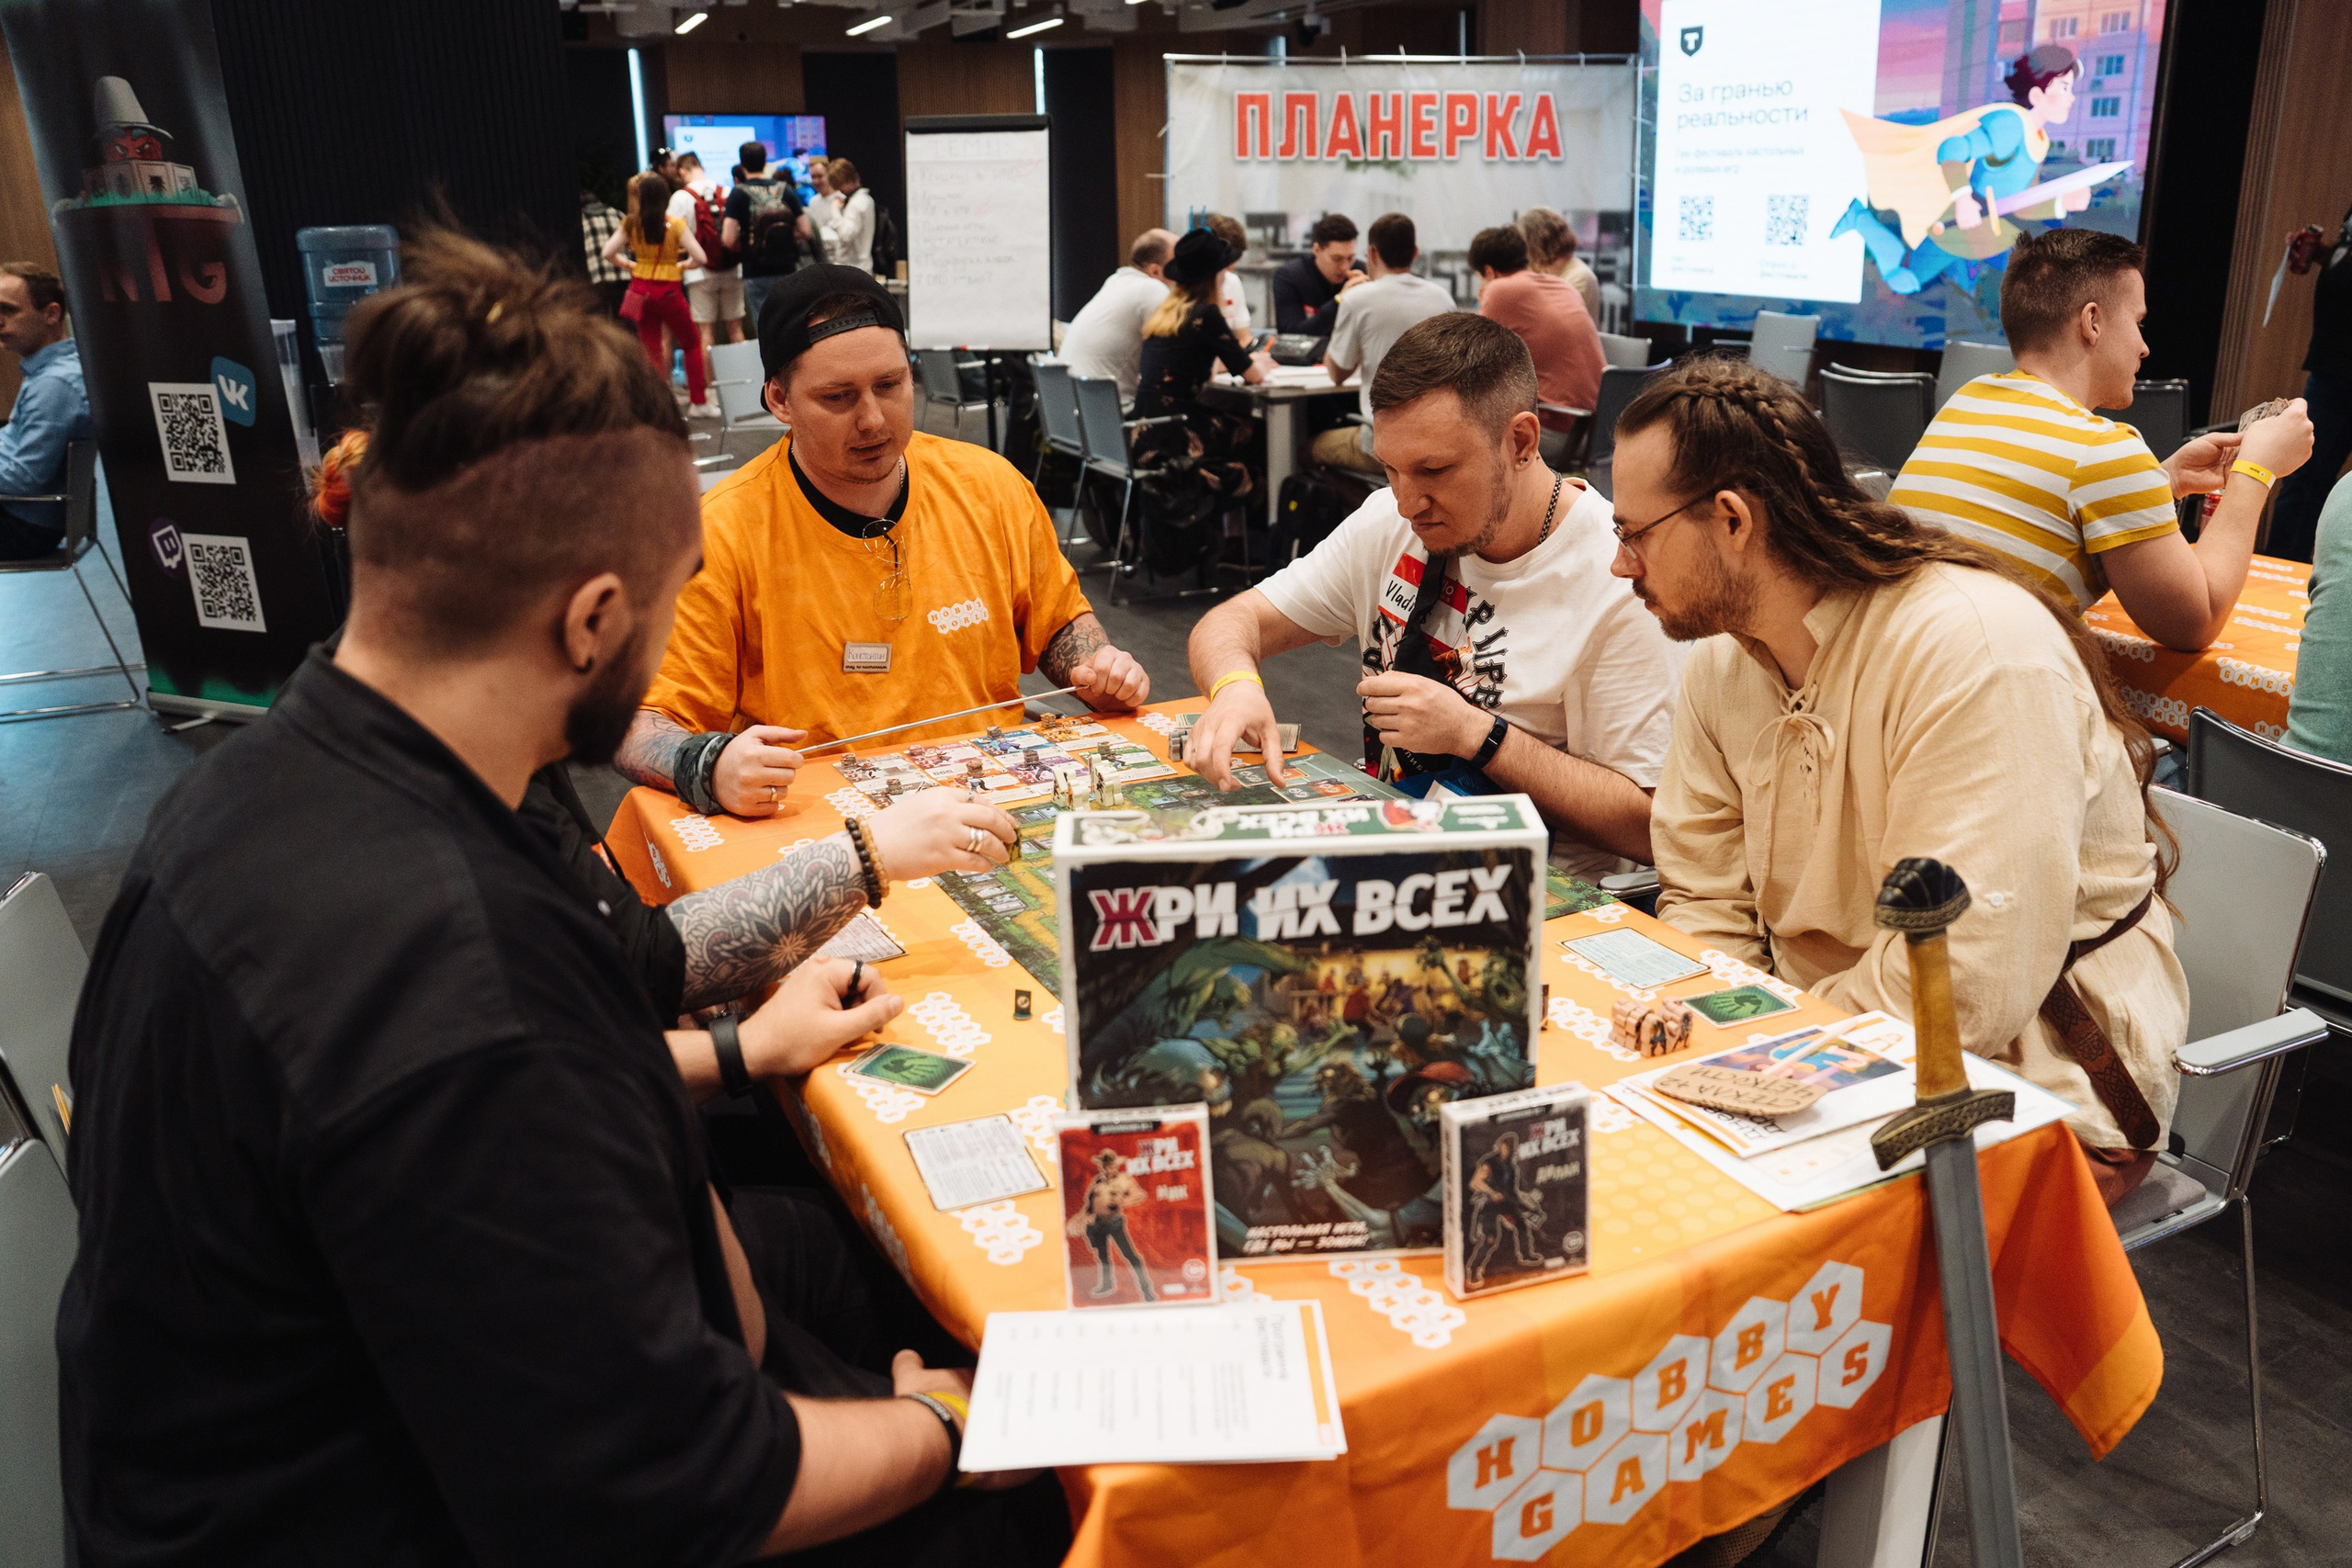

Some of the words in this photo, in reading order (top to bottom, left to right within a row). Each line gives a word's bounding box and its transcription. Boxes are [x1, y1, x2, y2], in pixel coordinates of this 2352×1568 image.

[1679, 83, 1704, 103] За
[1711, 80, 1793, 104] гранью
[1234, 89, 1565, 163] ПЛАНЕРКА
[1678, 107, 1808, 132] реальности
[931, 601, 982, 622] HOBBY
[2223, 670, 2289, 693] GAMES
[1089, 881, 1239, 953] ЖРИ
[1253, 878, 1342, 942] ИХ
[1352, 863, 1514, 937] ВСЕХ
[1474, 1283, 1841, 1490] HOBBY
[1520, 1341, 1870, 1540] GAMES
